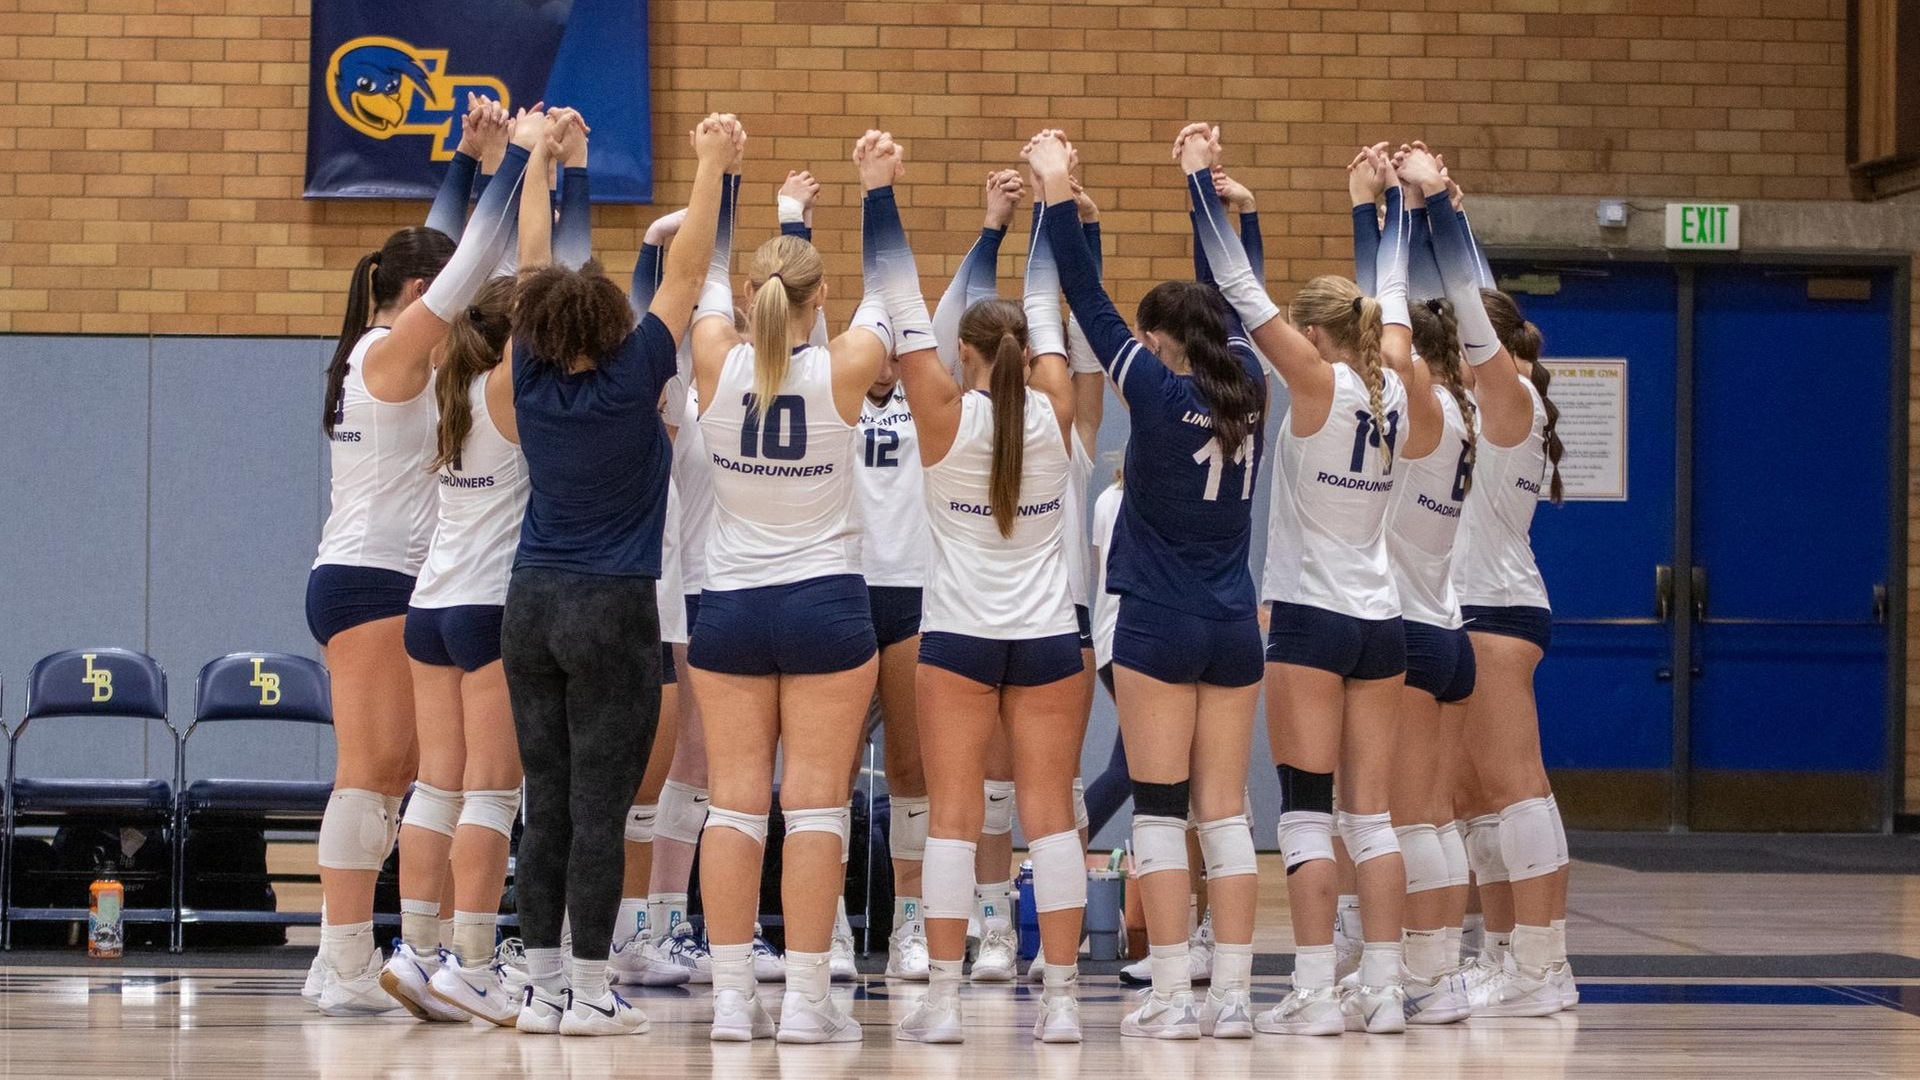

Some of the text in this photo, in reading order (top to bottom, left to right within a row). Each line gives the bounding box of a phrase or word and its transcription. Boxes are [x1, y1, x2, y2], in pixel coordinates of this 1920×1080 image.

[1682, 207, 1729, 244] EXIT
[1559, 368, 1576, 378] FOR
[1580, 368, 1596, 378] THE
[1598, 368, 1619, 378] GYM
[741, 391, 807, 461] 10
[712, 452, 835, 478] ROADRUNNERS
[864, 427, 900, 467] 12
[1192, 433, 1255, 501] 11
[949, 498, 1061, 517] ROADNNERS
[82, 653, 113, 702] LB
[250, 657, 281, 706] LB
